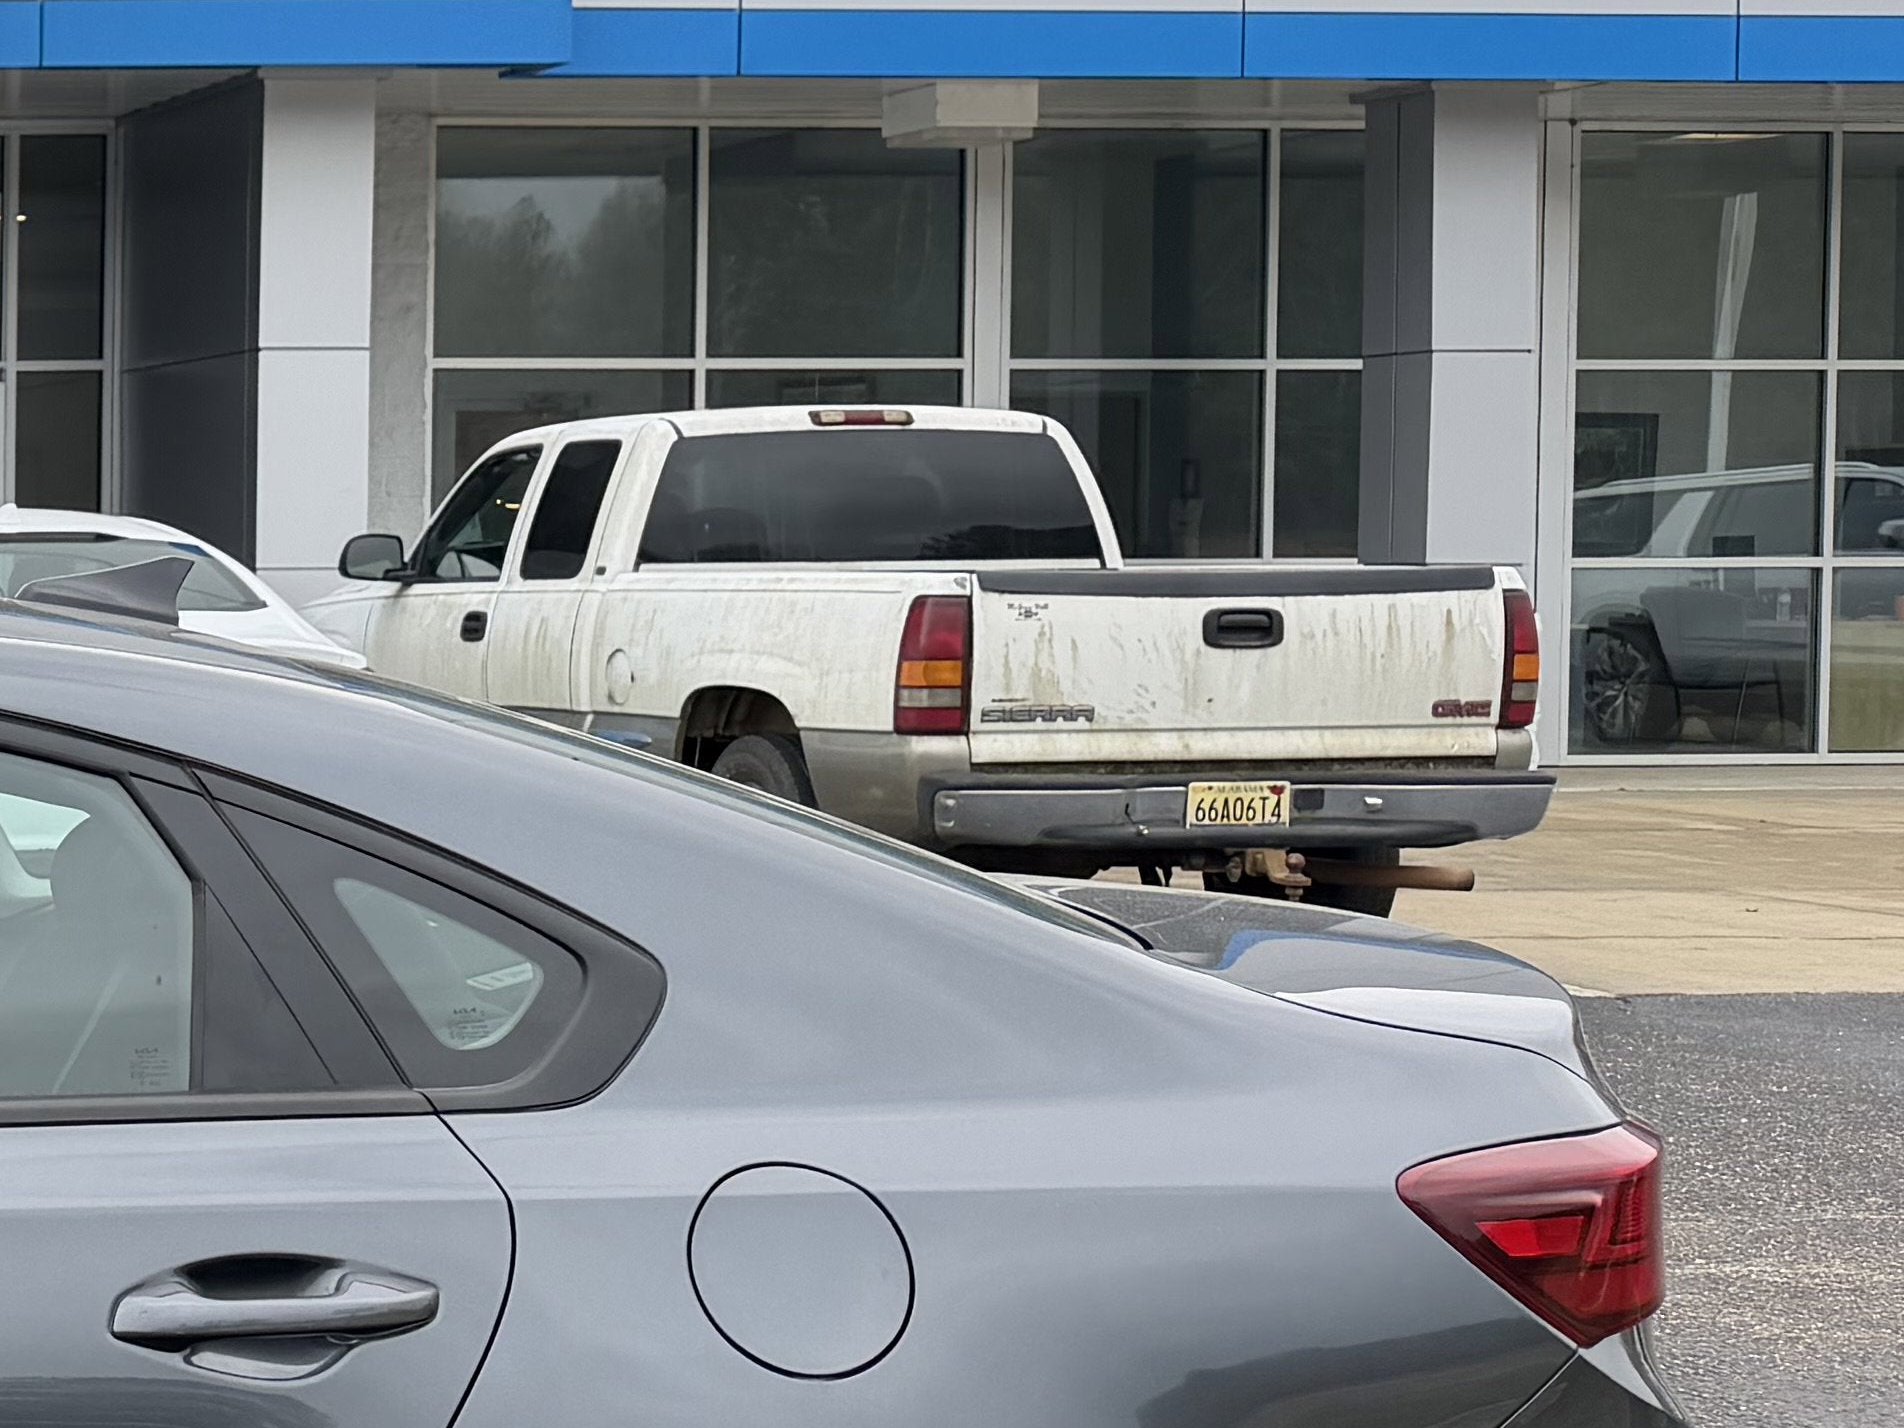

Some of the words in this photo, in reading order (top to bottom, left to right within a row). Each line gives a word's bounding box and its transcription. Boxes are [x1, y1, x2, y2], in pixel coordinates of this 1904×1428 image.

[980, 705, 1095, 722] SIERRA
[1432, 699, 1492, 717] GMC
[1195, 796, 1281, 823] 66A06T4
